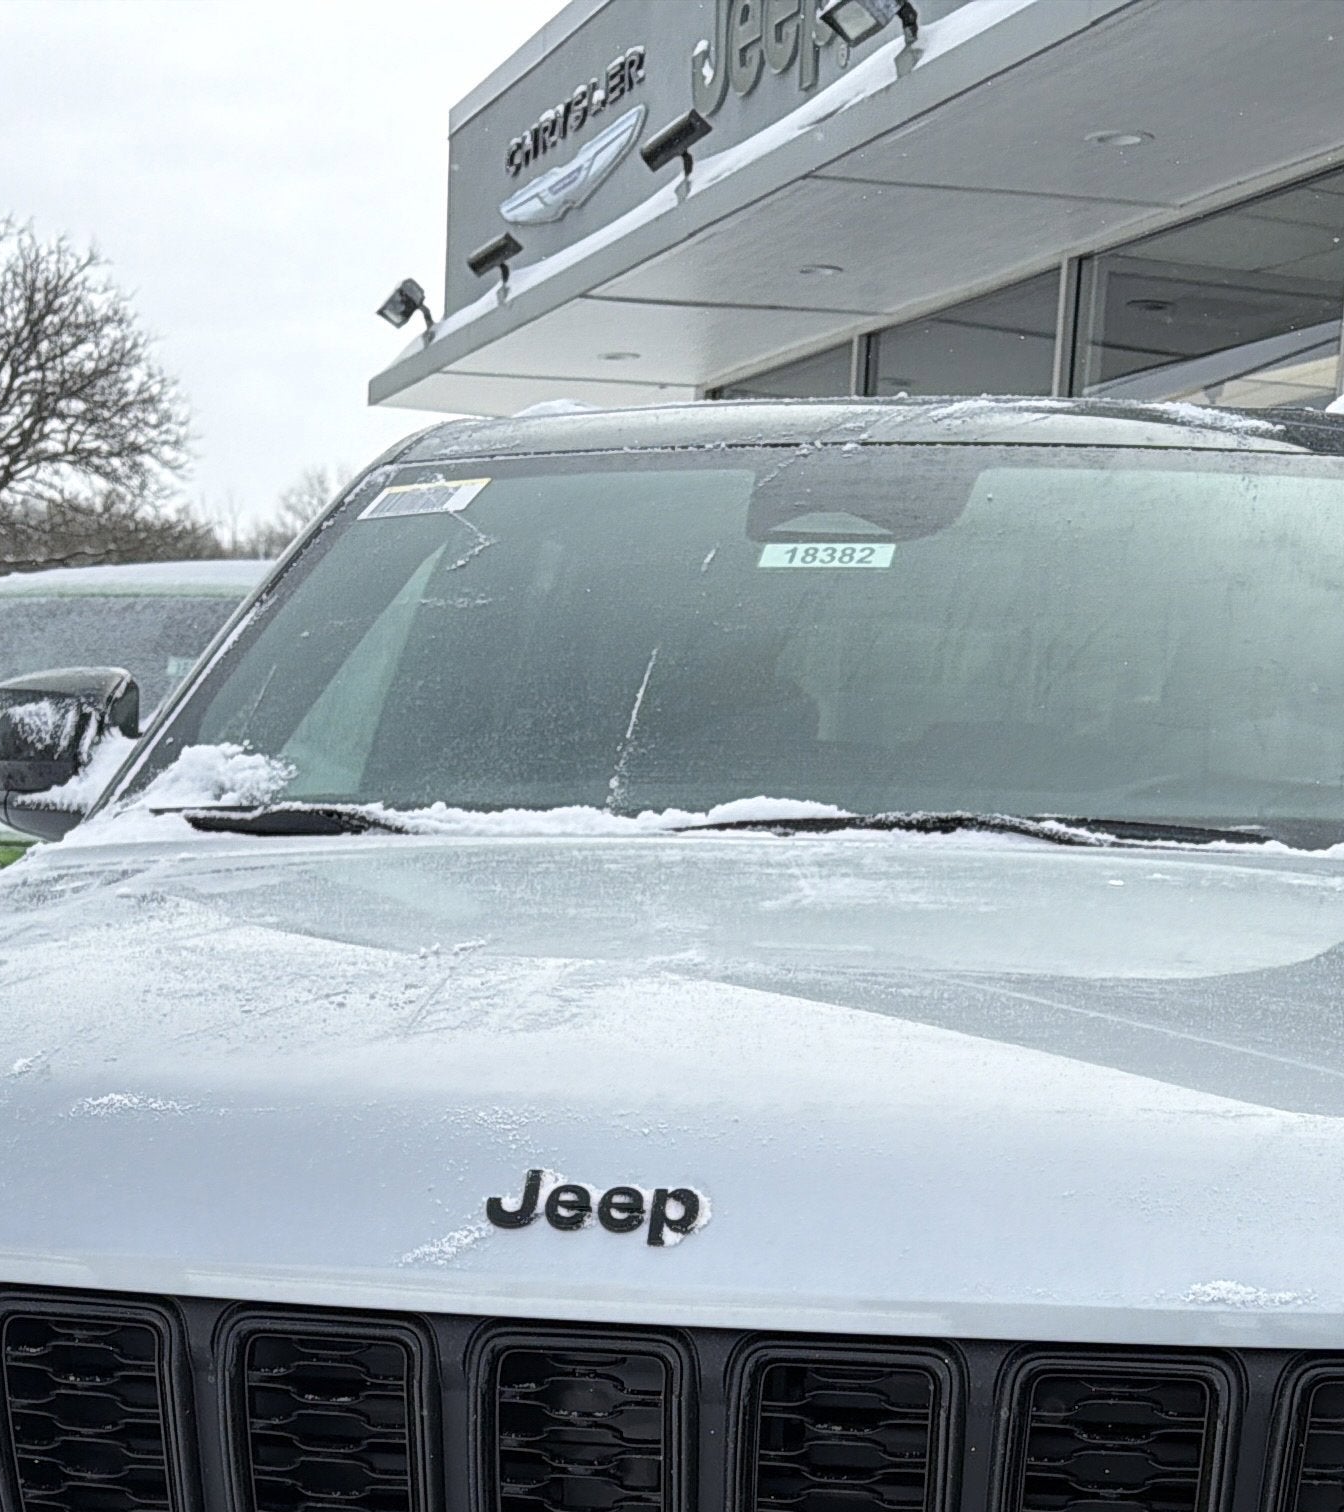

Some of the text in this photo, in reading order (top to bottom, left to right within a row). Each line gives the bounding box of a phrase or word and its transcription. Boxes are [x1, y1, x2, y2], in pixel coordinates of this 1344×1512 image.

[506, 46, 645, 177] CHRYSLER
[784, 546, 876, 564] 18382
[486, 1169, 700, 1247] Jeep
